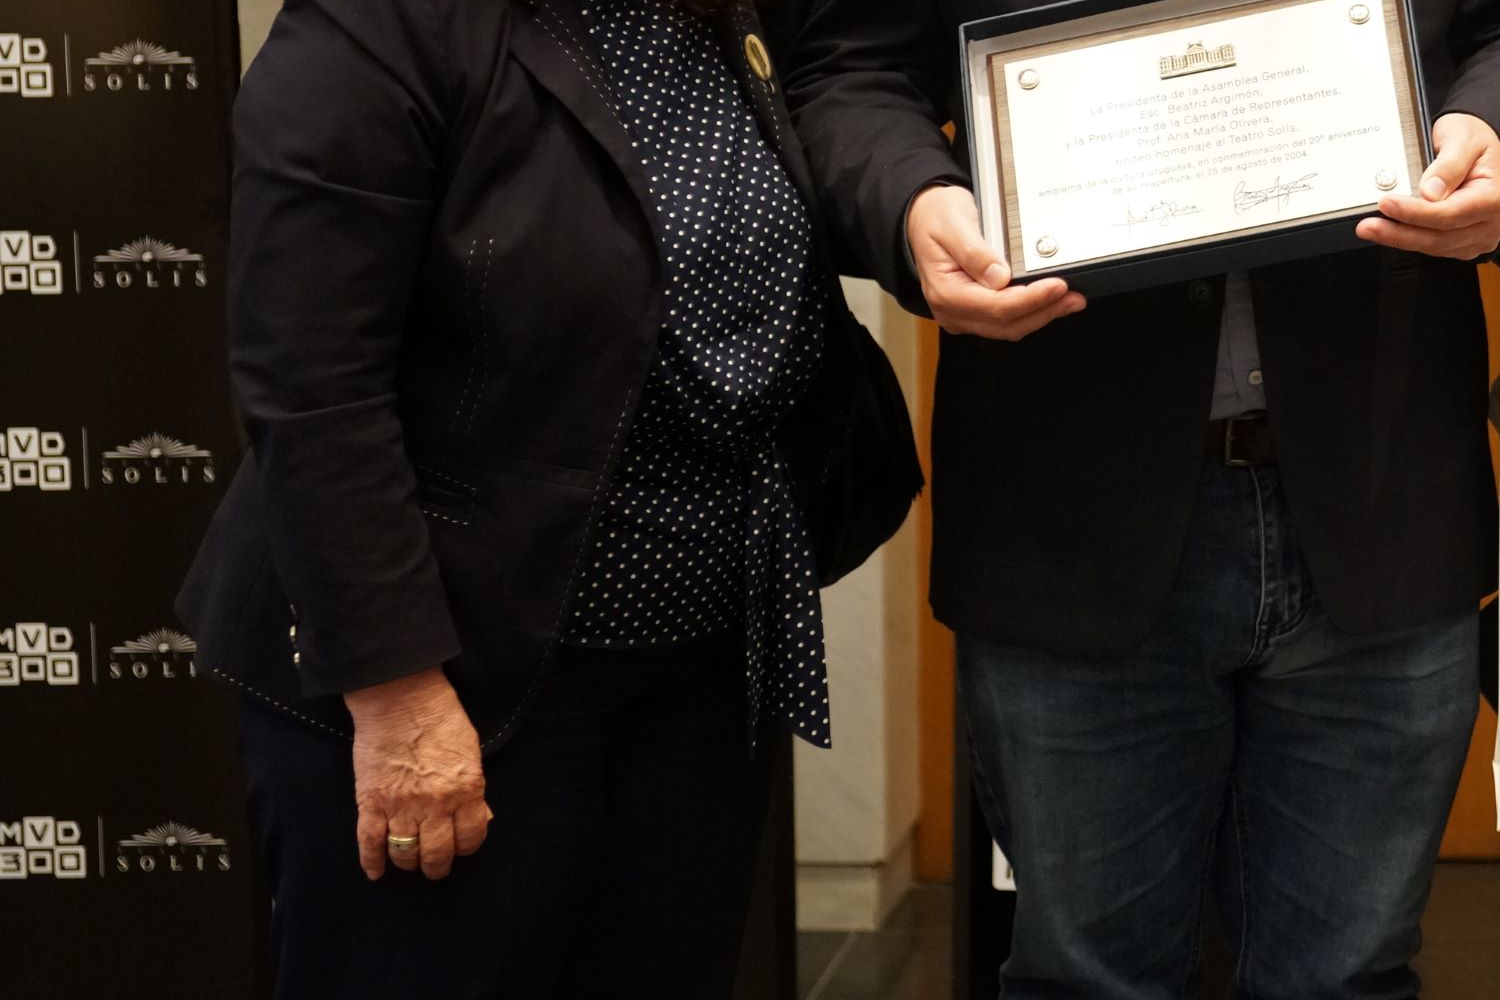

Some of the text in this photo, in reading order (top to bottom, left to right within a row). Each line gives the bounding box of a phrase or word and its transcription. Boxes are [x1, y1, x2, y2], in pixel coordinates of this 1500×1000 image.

[0, 33, 48, 67] VD
[0, 63, 54, 98] 00
[84, 73, 200, 91] SOLIS
[1106, 94, 1167, 110] Presidenta
[1202, 76, 1258, 93] Asamblea
[1261, 65, 1309, 81] General,
[1168, 100, 1207, 114] Beatriz
[1088, 126, 1149, 141] Presidenta
[1184, 110, 1228, 125] Cámara
[1167, 132, 1189, 141] Ana
[1193, 124, 1226, 136] María
[1155, 142, 1212, 157] homenaje
[1229, 131, 1264, 143] Teatro
[1038, 184, 1082, 197] emblema
[1212, 143, 1288, 164] conmemoración
[1292, 138, 1306, 148] del
[1236, 159, 1268, 171] agosto
[0, 231, 57, 265] VD
[0, 260, 63, 295] 00
[93, 270, 209, 288] SOLIS
[0, 427, 65, 460] VD
[0, 457, 71, 491] 00
[101, 466, 217, 484] SOLIS
[109, 661, 197, 680] SOLI
[0, 816, 81, 850] MVD
[116, 854, 232, 873] SOLIS
